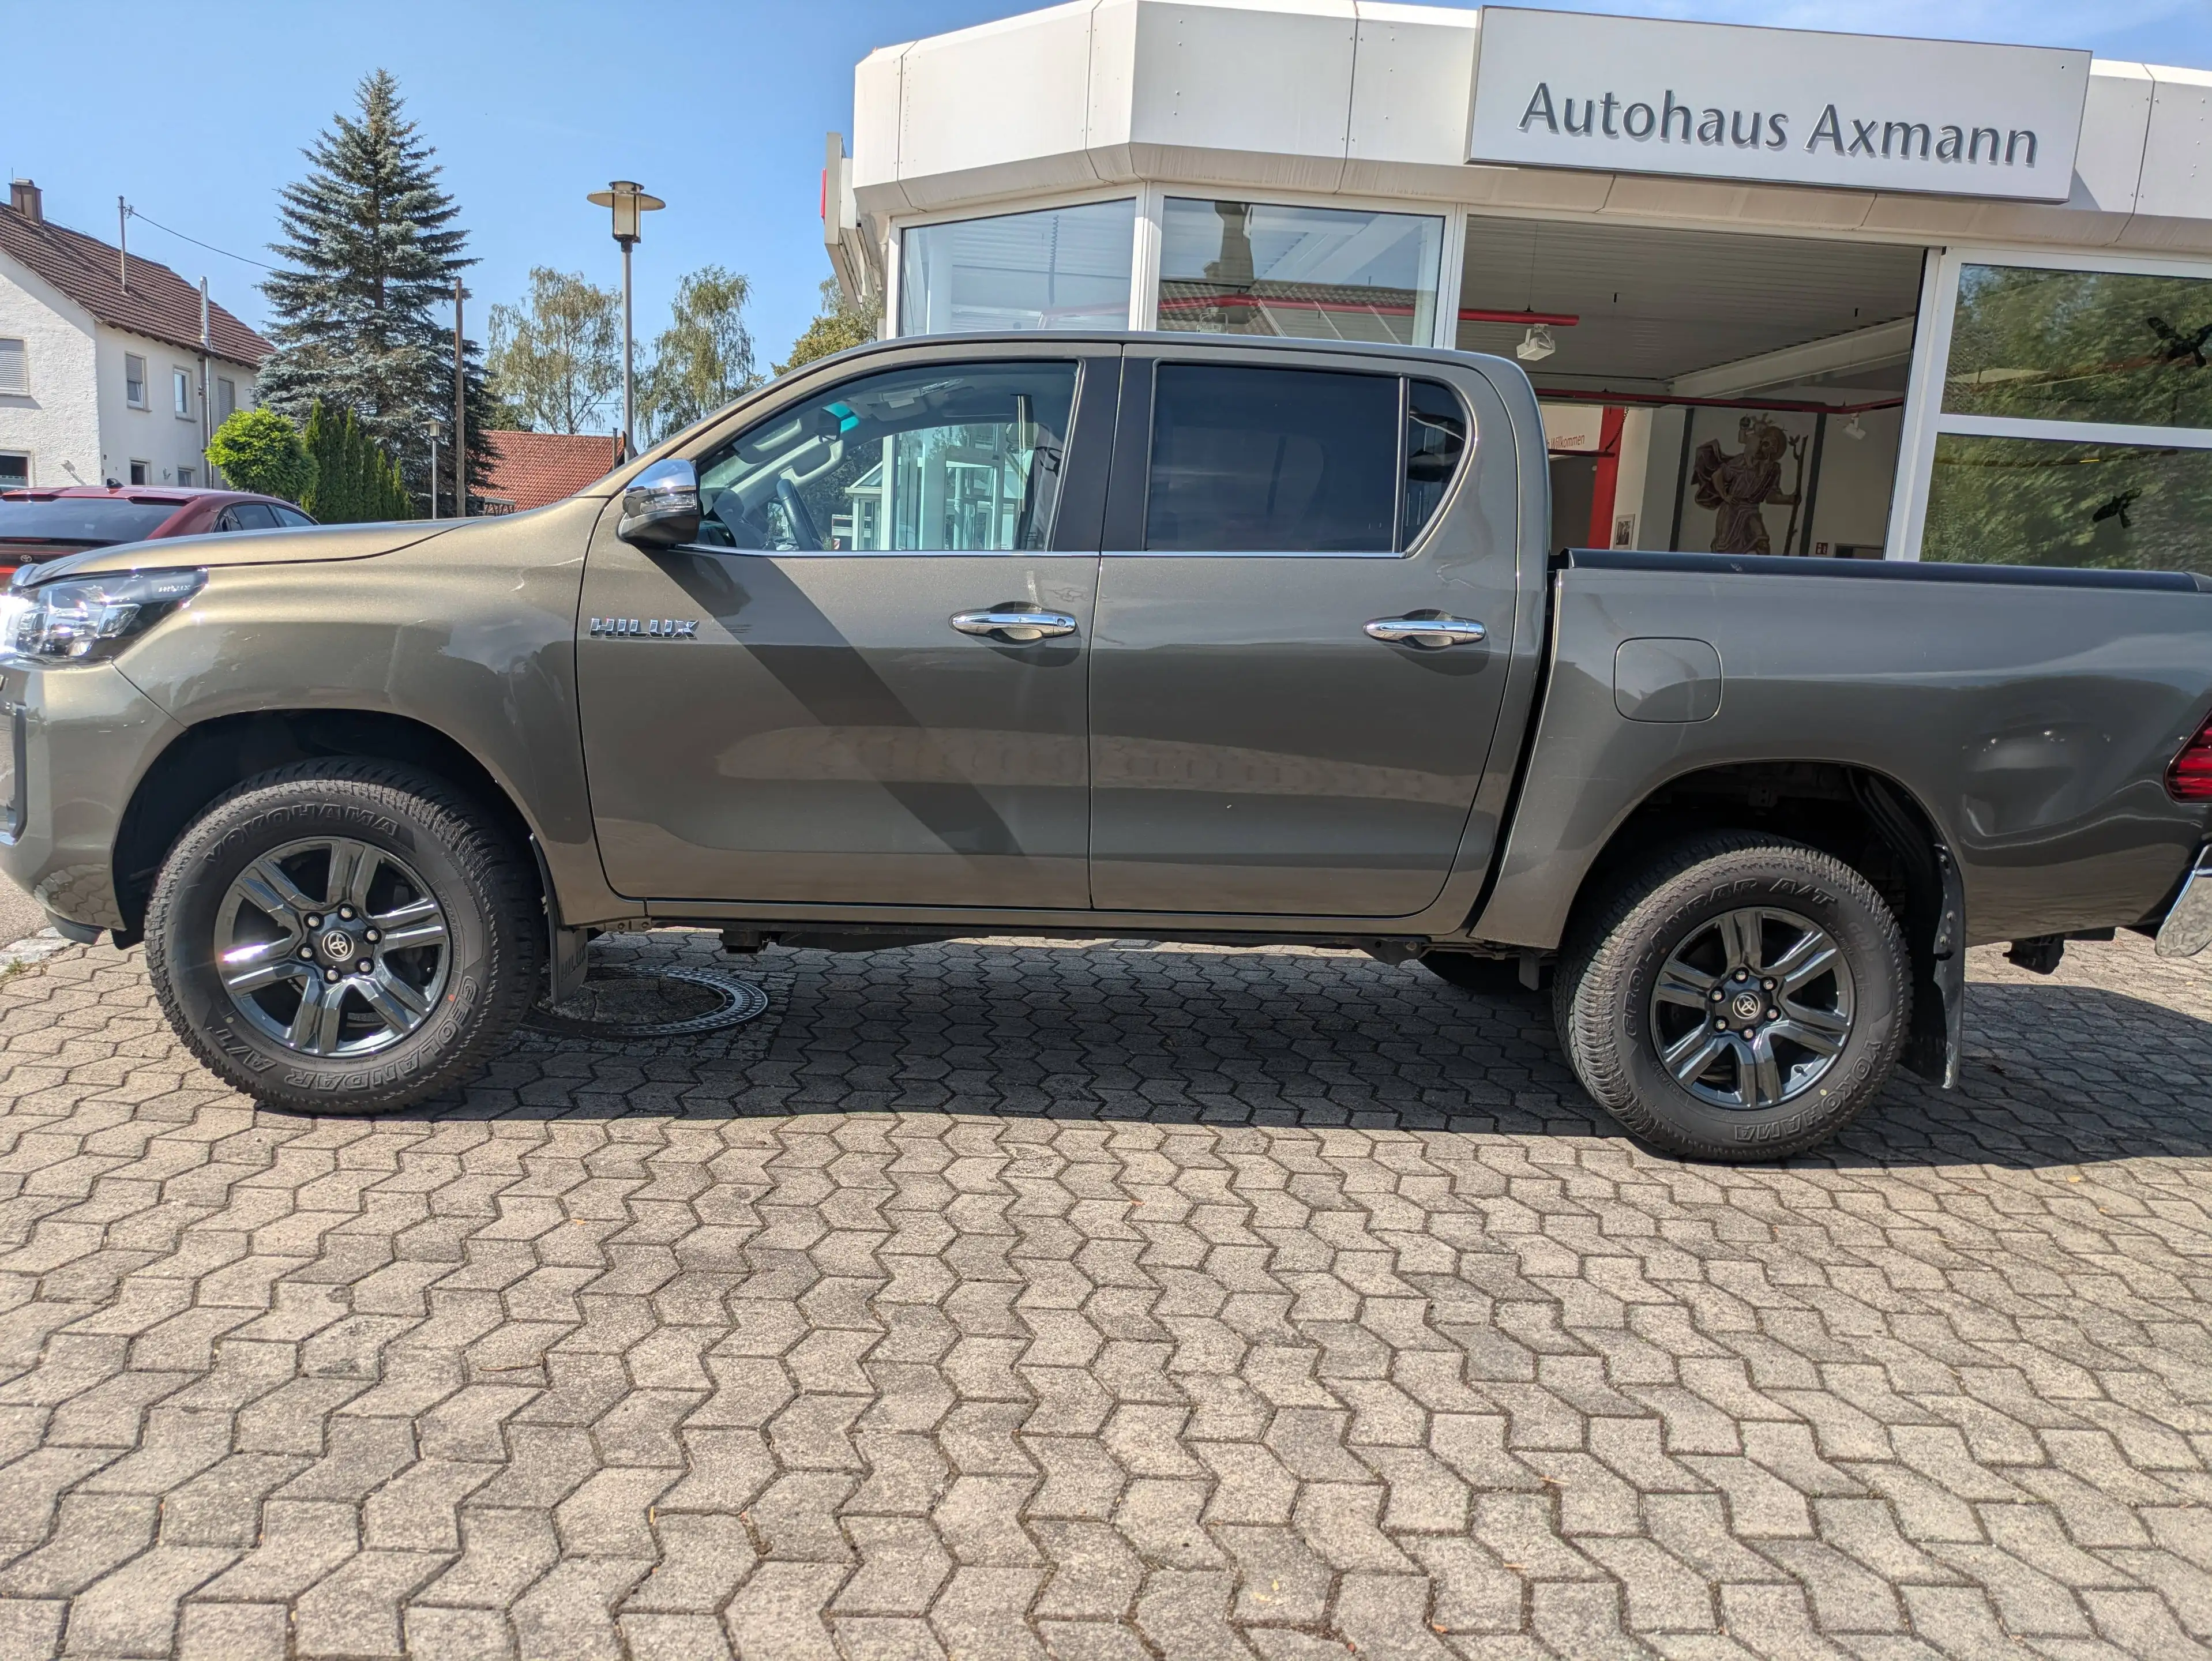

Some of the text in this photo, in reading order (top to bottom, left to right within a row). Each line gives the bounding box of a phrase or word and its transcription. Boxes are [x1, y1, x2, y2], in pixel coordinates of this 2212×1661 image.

[1516, 81, 2038, 168] Autohaus Axmann
[1551, 434, 1585, 450] Willkommen
[589, 617, 700, 639] HILUX
[202, 803, 400, 865] YOKOHAMA
[1769, 878, 1838, 904] A/T
[206, 975, 478, 1092] GEOLANDAR A/T
[1735, 1040, 1883, 1143] YOKOHAMA
